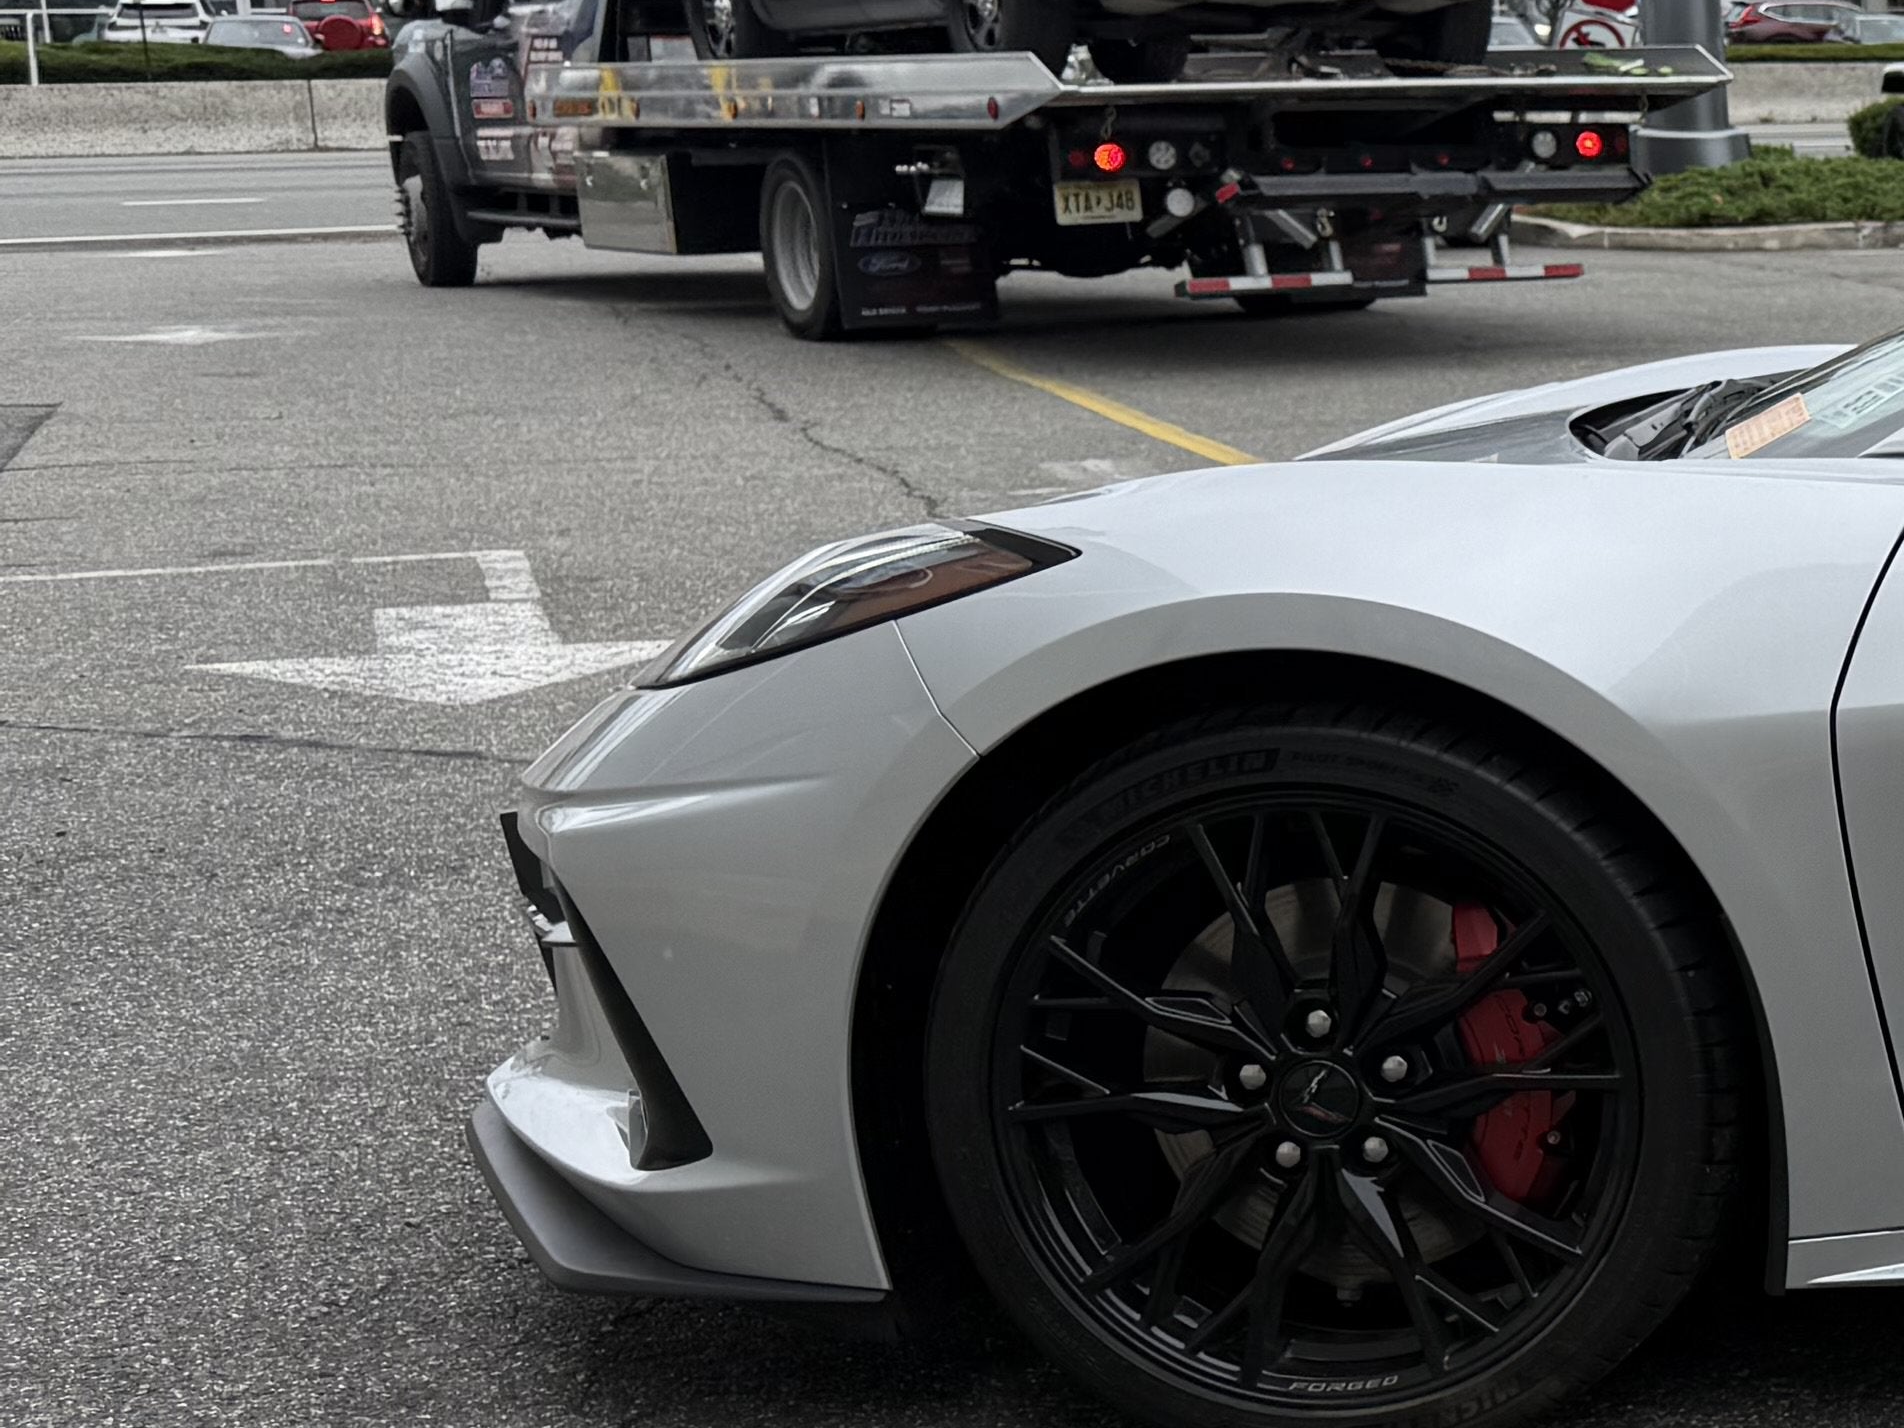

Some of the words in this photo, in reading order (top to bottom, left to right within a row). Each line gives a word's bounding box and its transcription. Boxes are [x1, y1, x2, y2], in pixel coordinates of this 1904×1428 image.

[1102, 750, 1272, 821] MICHELIN
[1063, 833, 1171, 928] CORVETTE
[1287, 1374, 1400, 1393] FORGED
